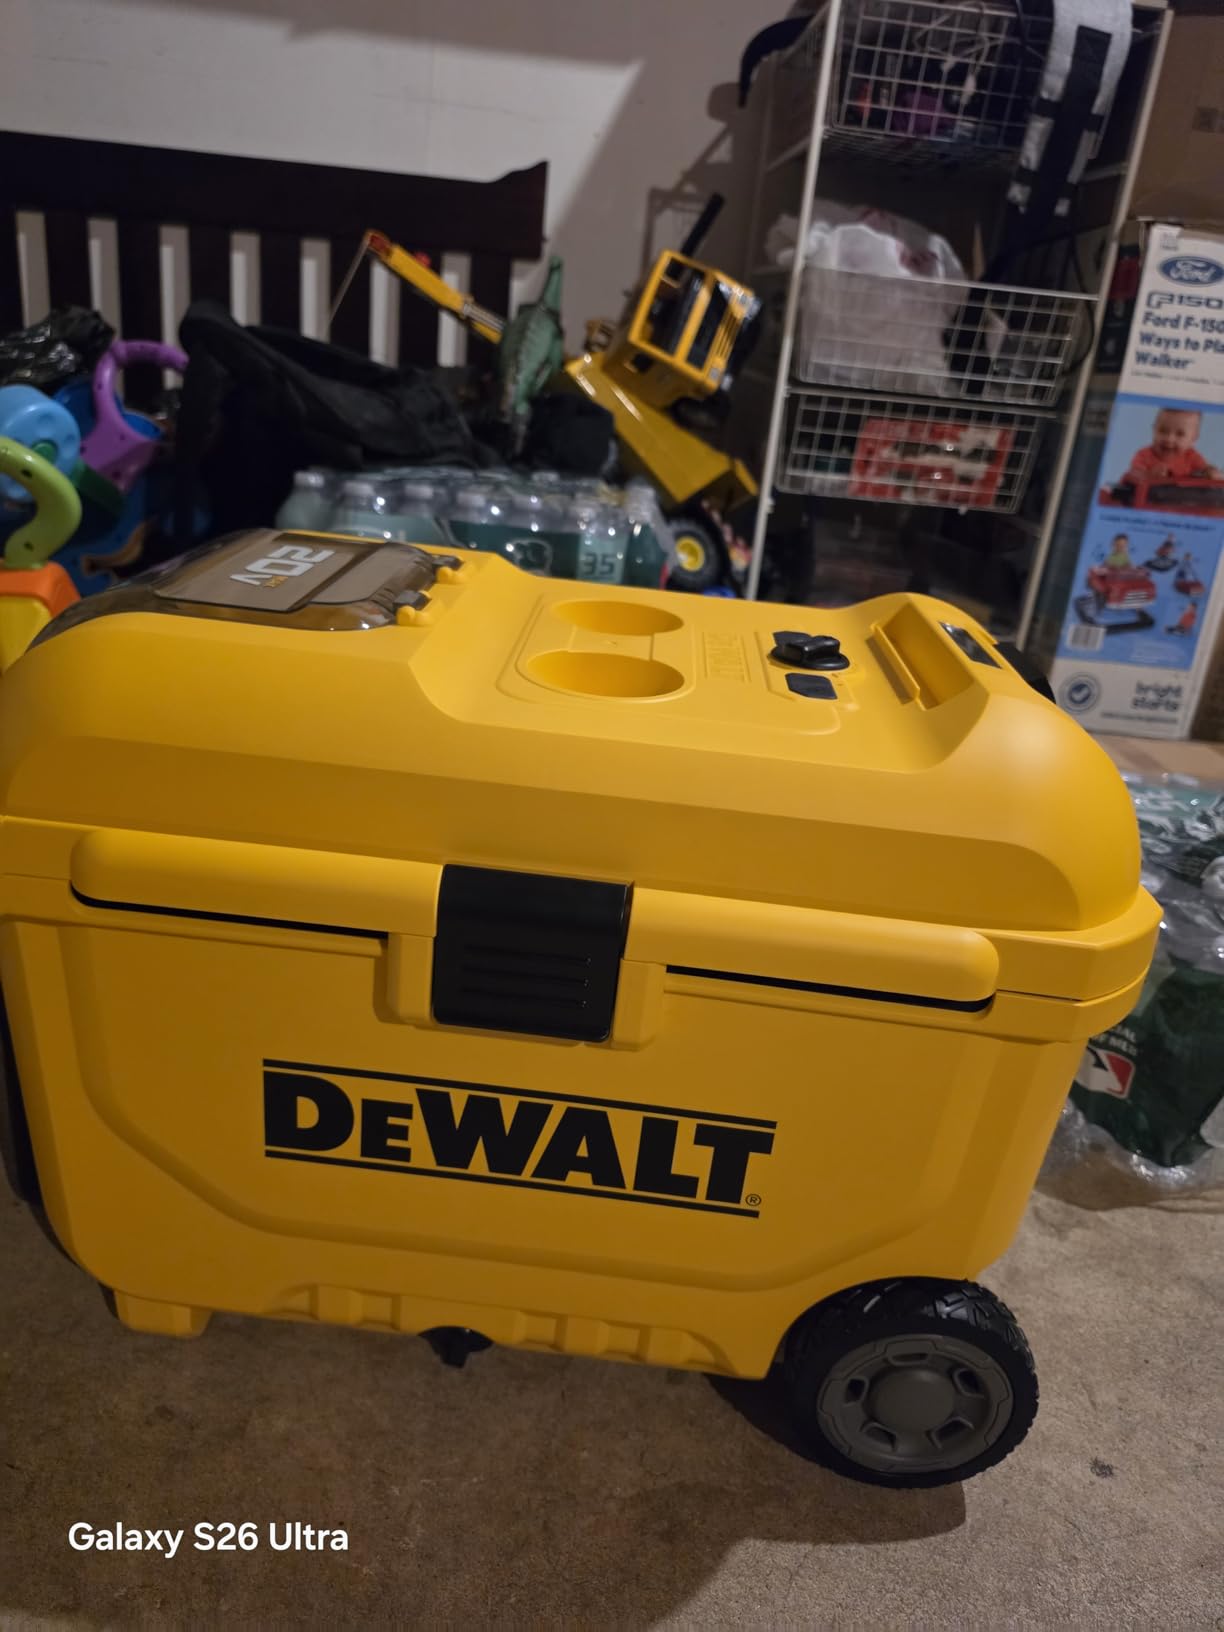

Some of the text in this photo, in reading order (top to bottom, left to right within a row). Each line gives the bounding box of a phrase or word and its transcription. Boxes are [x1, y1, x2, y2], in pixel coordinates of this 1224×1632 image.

[1170, 260, 1217, 283] Ford
[1142, 310, 1182, 329] Ford
[1139, 331, 1180, 351] Ways
[1184, 337, 1200, 351] to
[1135, 351, 1188, 369] Walker
[583, 552, 615, 576] 35
